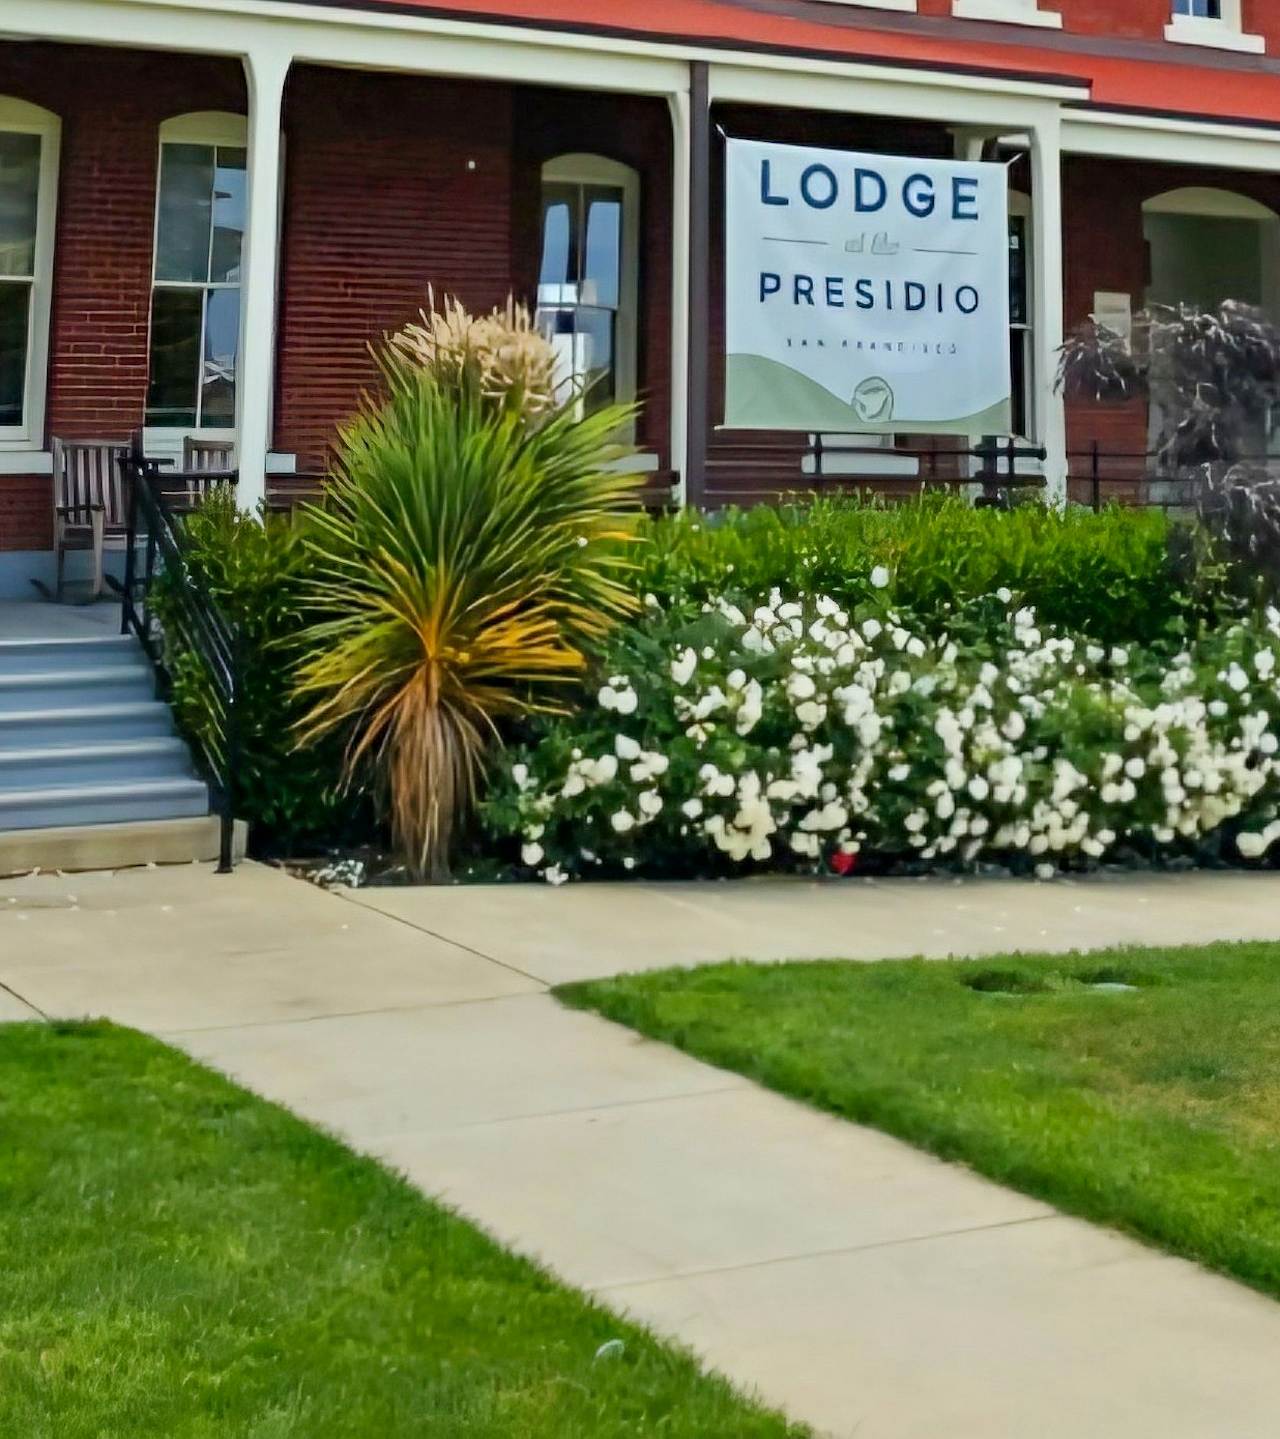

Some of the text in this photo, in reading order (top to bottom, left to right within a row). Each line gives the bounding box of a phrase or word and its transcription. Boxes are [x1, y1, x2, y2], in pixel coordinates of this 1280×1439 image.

[760, 159, 979, 220] LODGE
[759, 271, 979, 314] PRESIDIO
[786, 338, 825, 348] AN
